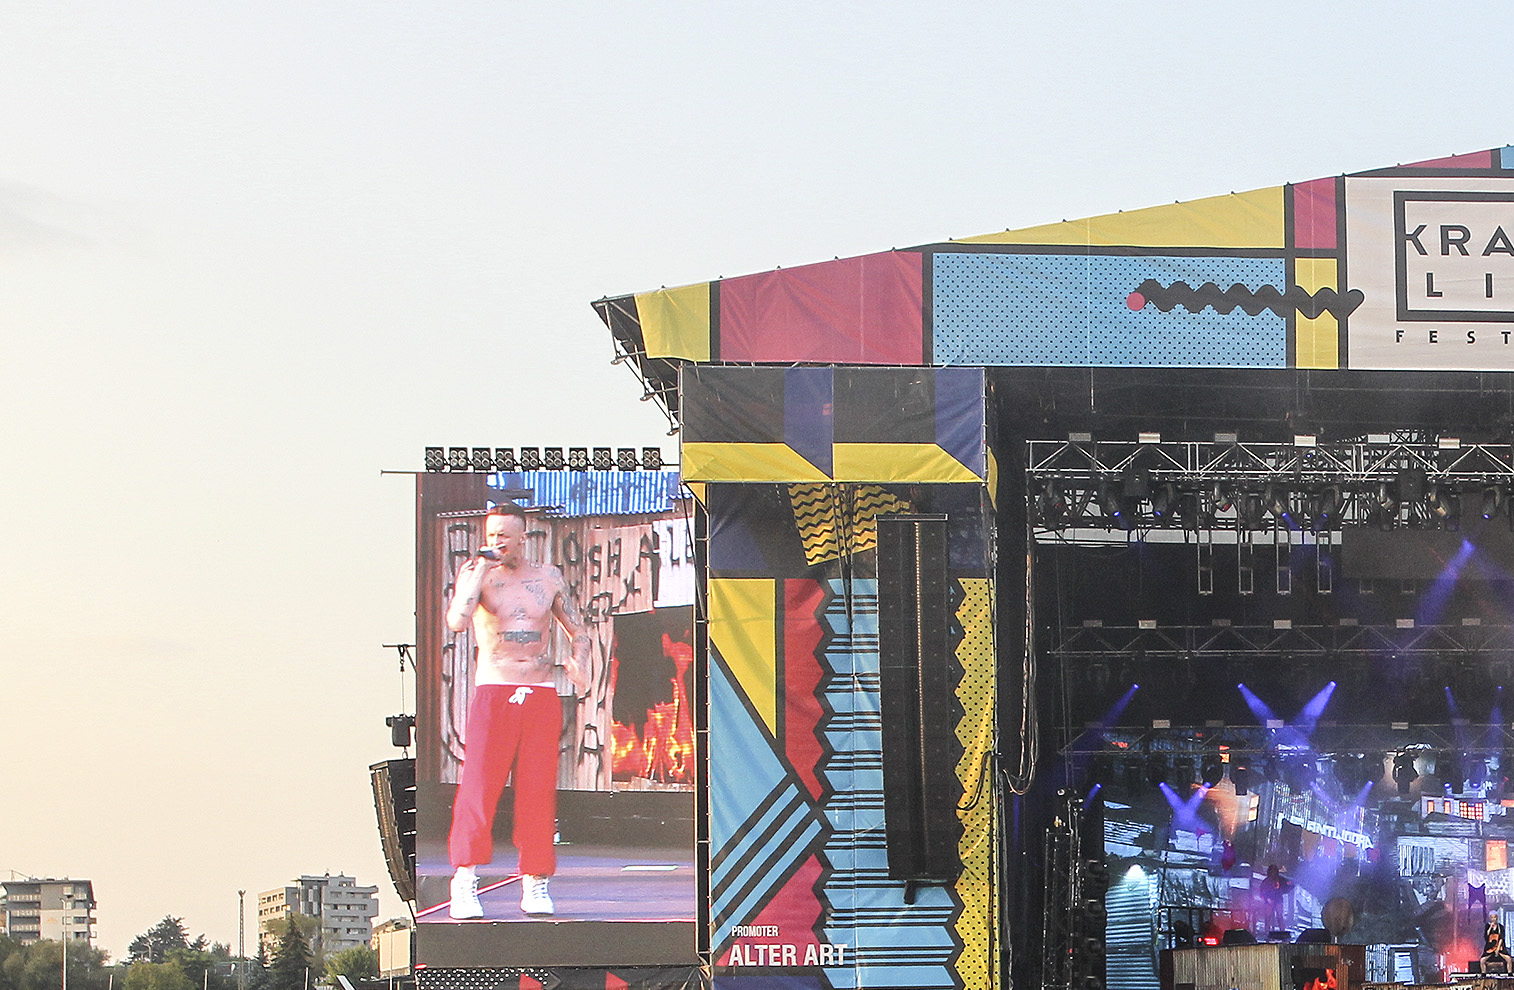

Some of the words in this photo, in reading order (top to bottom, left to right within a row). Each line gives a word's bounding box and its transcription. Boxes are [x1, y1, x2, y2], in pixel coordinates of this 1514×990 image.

[731, 925, 779, 937] PROMOTER
[728, 944, 797, 966] ALTER
[803, 943, 848, 966] ART
